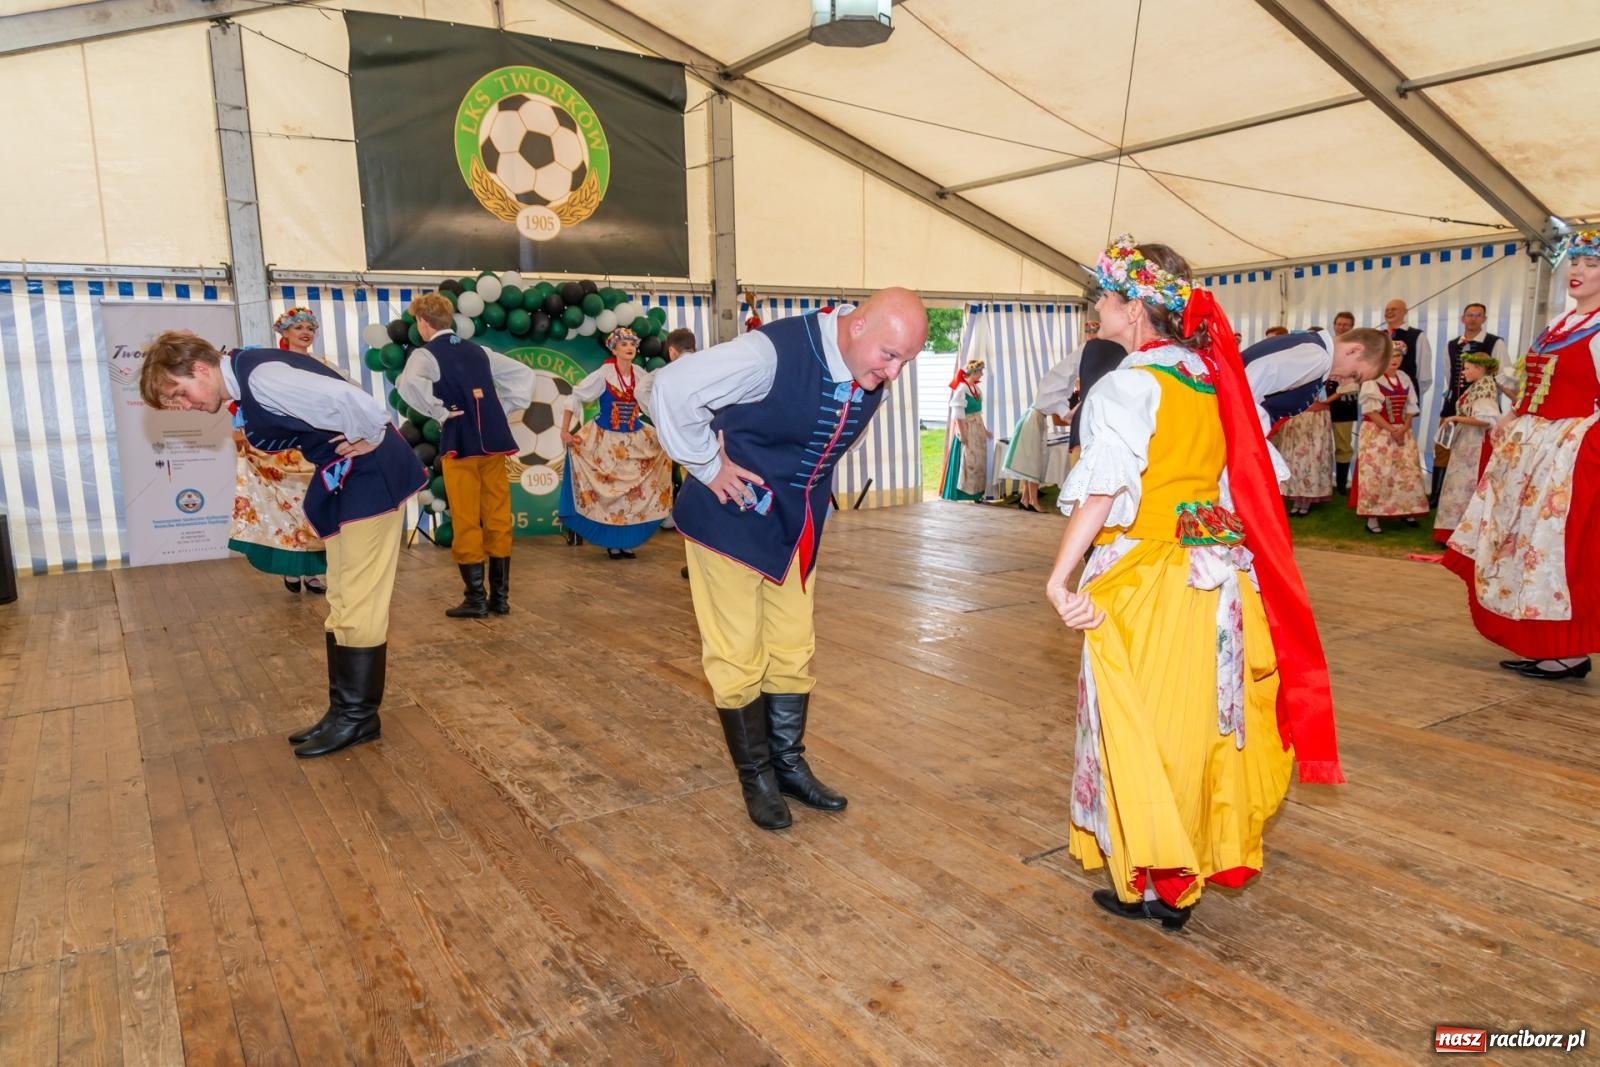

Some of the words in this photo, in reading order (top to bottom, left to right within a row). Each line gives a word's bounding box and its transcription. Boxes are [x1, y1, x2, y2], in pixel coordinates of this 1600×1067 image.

[461, 90, 491, 136] LKS
[494, 72, 605, 150] TWORKÓW
[523, 214, 555, 231] 1905
[526, 472, 554, 487] 1905
